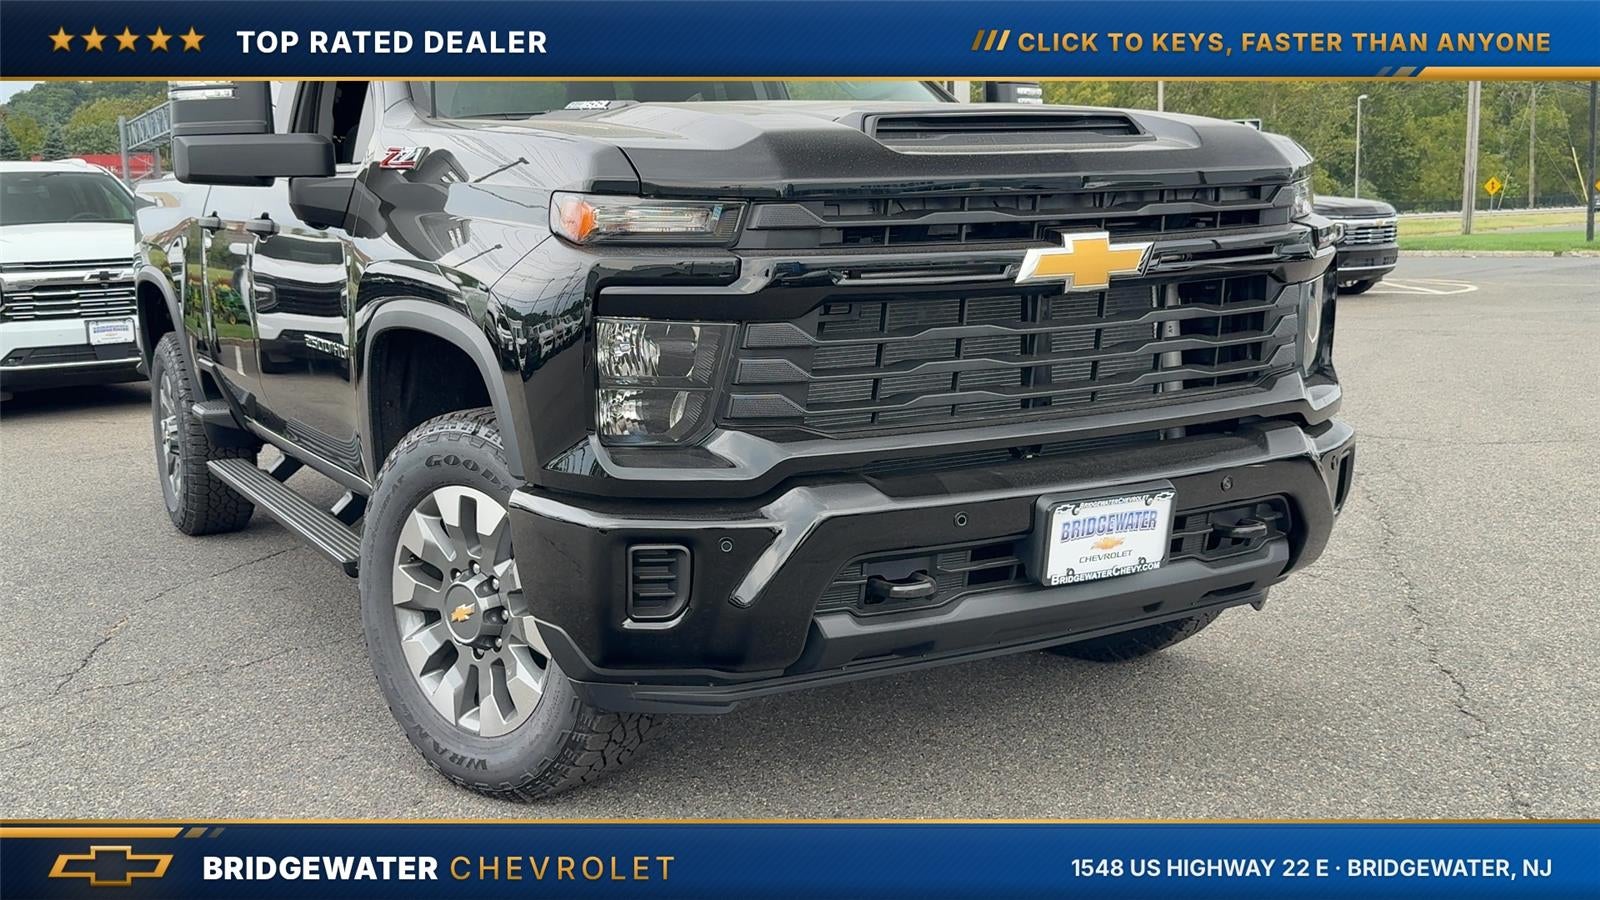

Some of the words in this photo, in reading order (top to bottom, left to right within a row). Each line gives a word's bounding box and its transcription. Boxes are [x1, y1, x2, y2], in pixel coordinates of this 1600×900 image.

[379, 146, 430, 170] Z71
[1060, 510, 1158, 543] BRIDGEWATER
[1079, 549, 1134, 564] CHEVROLET
